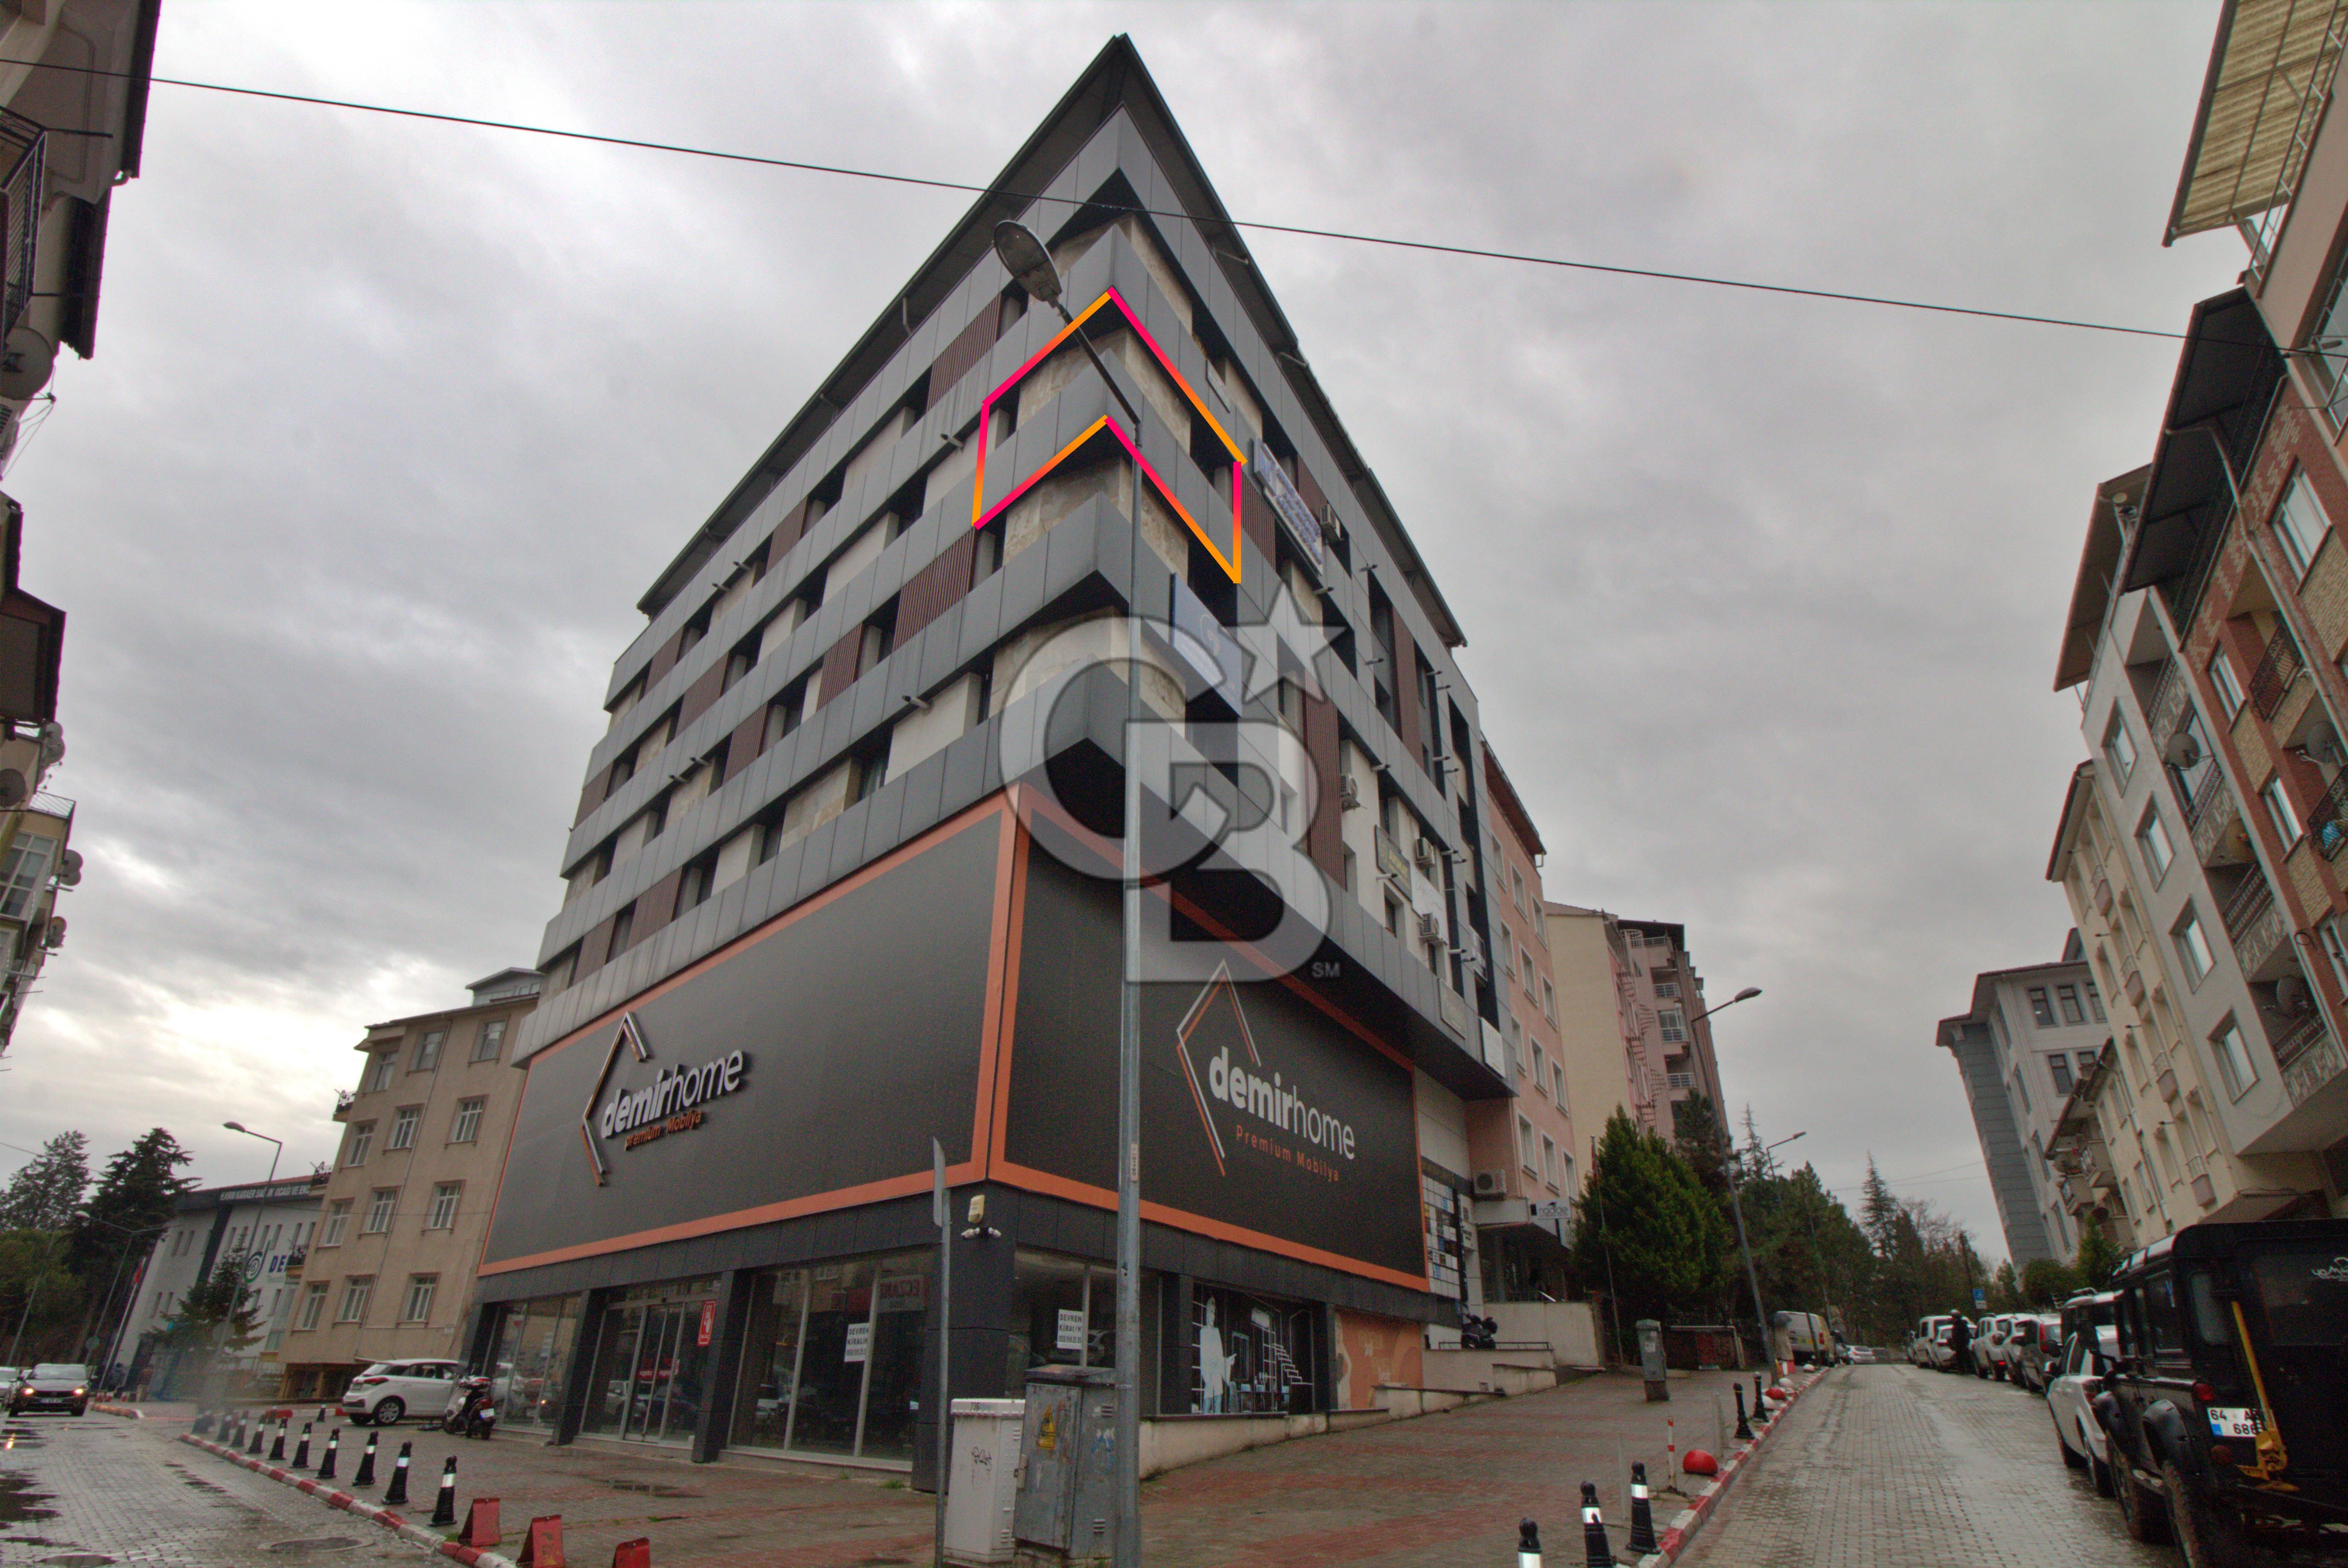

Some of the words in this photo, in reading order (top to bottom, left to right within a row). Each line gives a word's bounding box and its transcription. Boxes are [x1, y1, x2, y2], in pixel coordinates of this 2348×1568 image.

[601, 1050, 743, 1139] demirhome
[1209, 1045, 1355, 1160] demirhome
[665, 1109, 702, 1133] Mobilya
[1236, 1124, 1291, 1162] Premium
[1297, 1151, 1338, 1183] Mobilya
[268, 1254, 293, 1272] DE
[1059, 1323, 1082, 1332] KİRALIK
[1060, 1313, 1082, 1322] DEVREN
[2210, 1409, 2228, 1421] 64
